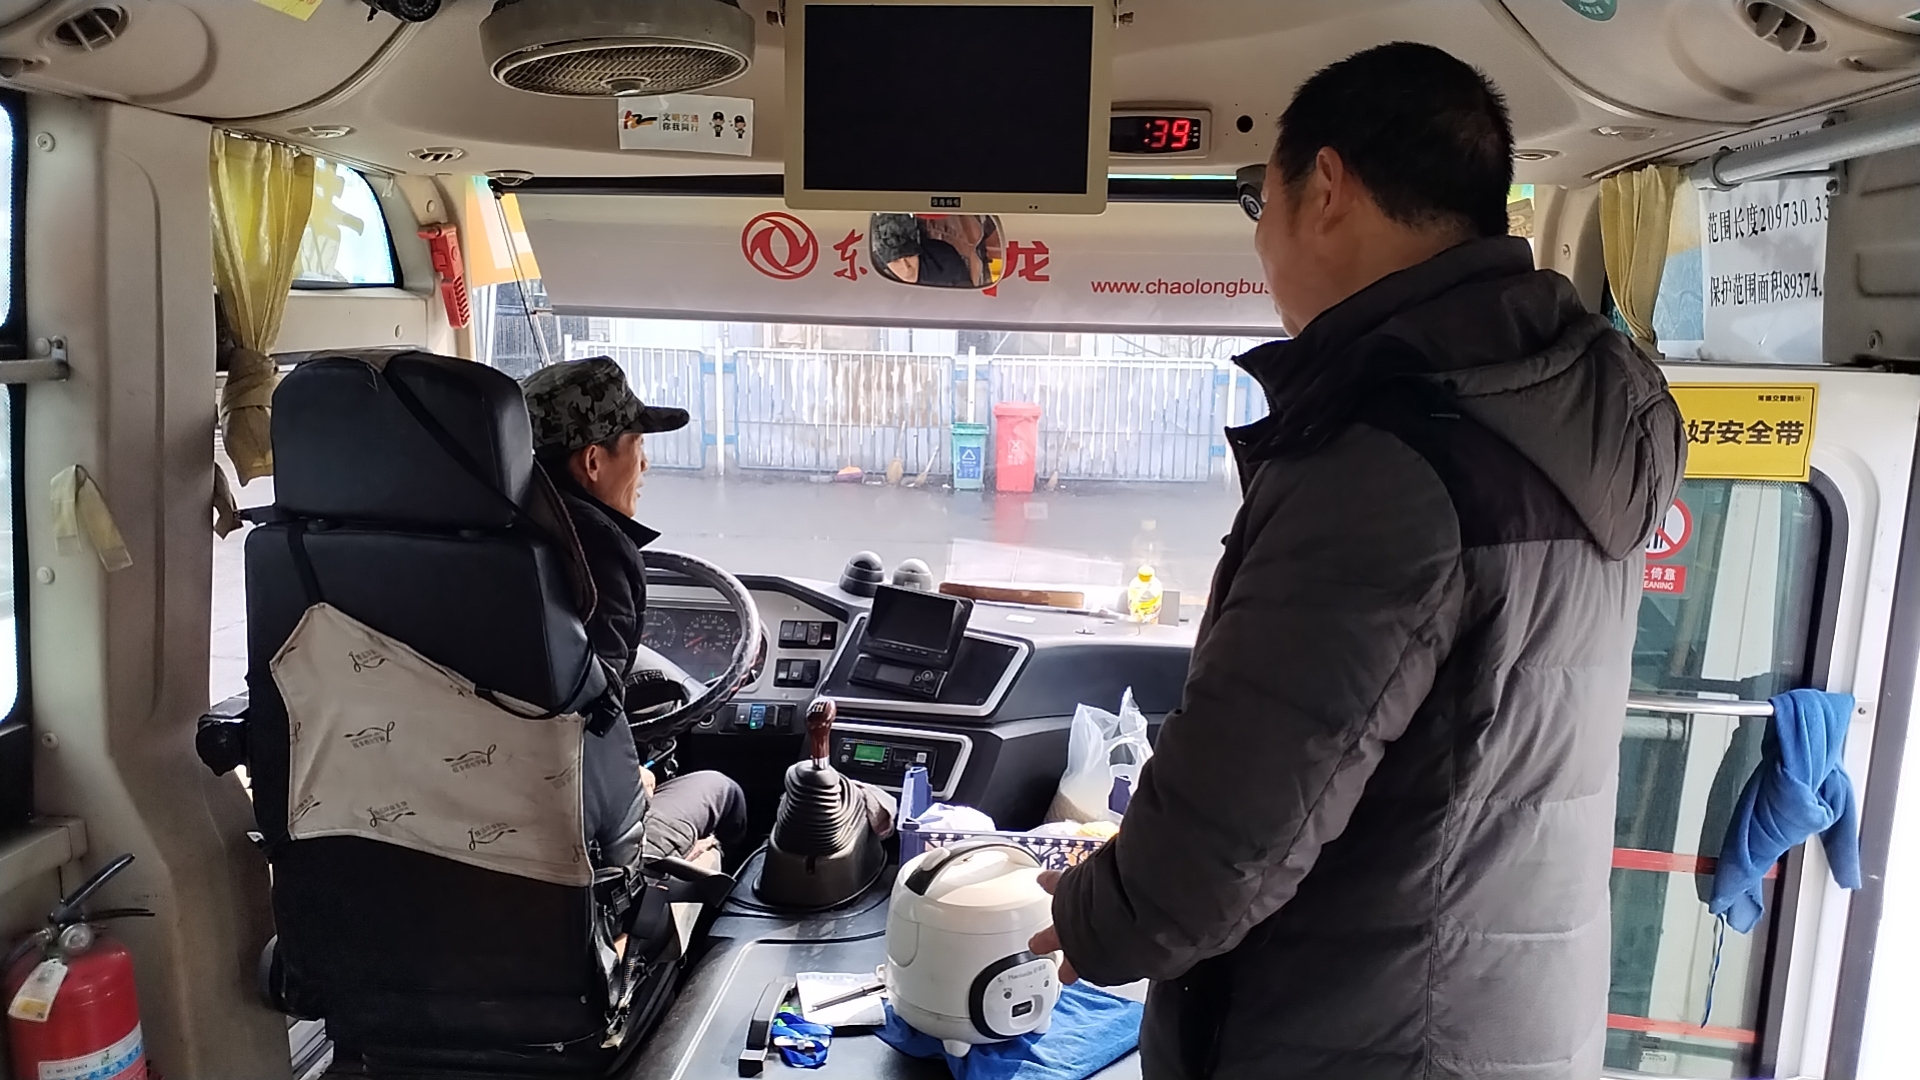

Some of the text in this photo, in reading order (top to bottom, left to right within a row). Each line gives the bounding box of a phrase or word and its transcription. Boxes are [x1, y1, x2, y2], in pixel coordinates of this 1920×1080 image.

[662, 122, 699, 132] 你我同行
[1687, 419, 1804, 446] 好安全带
